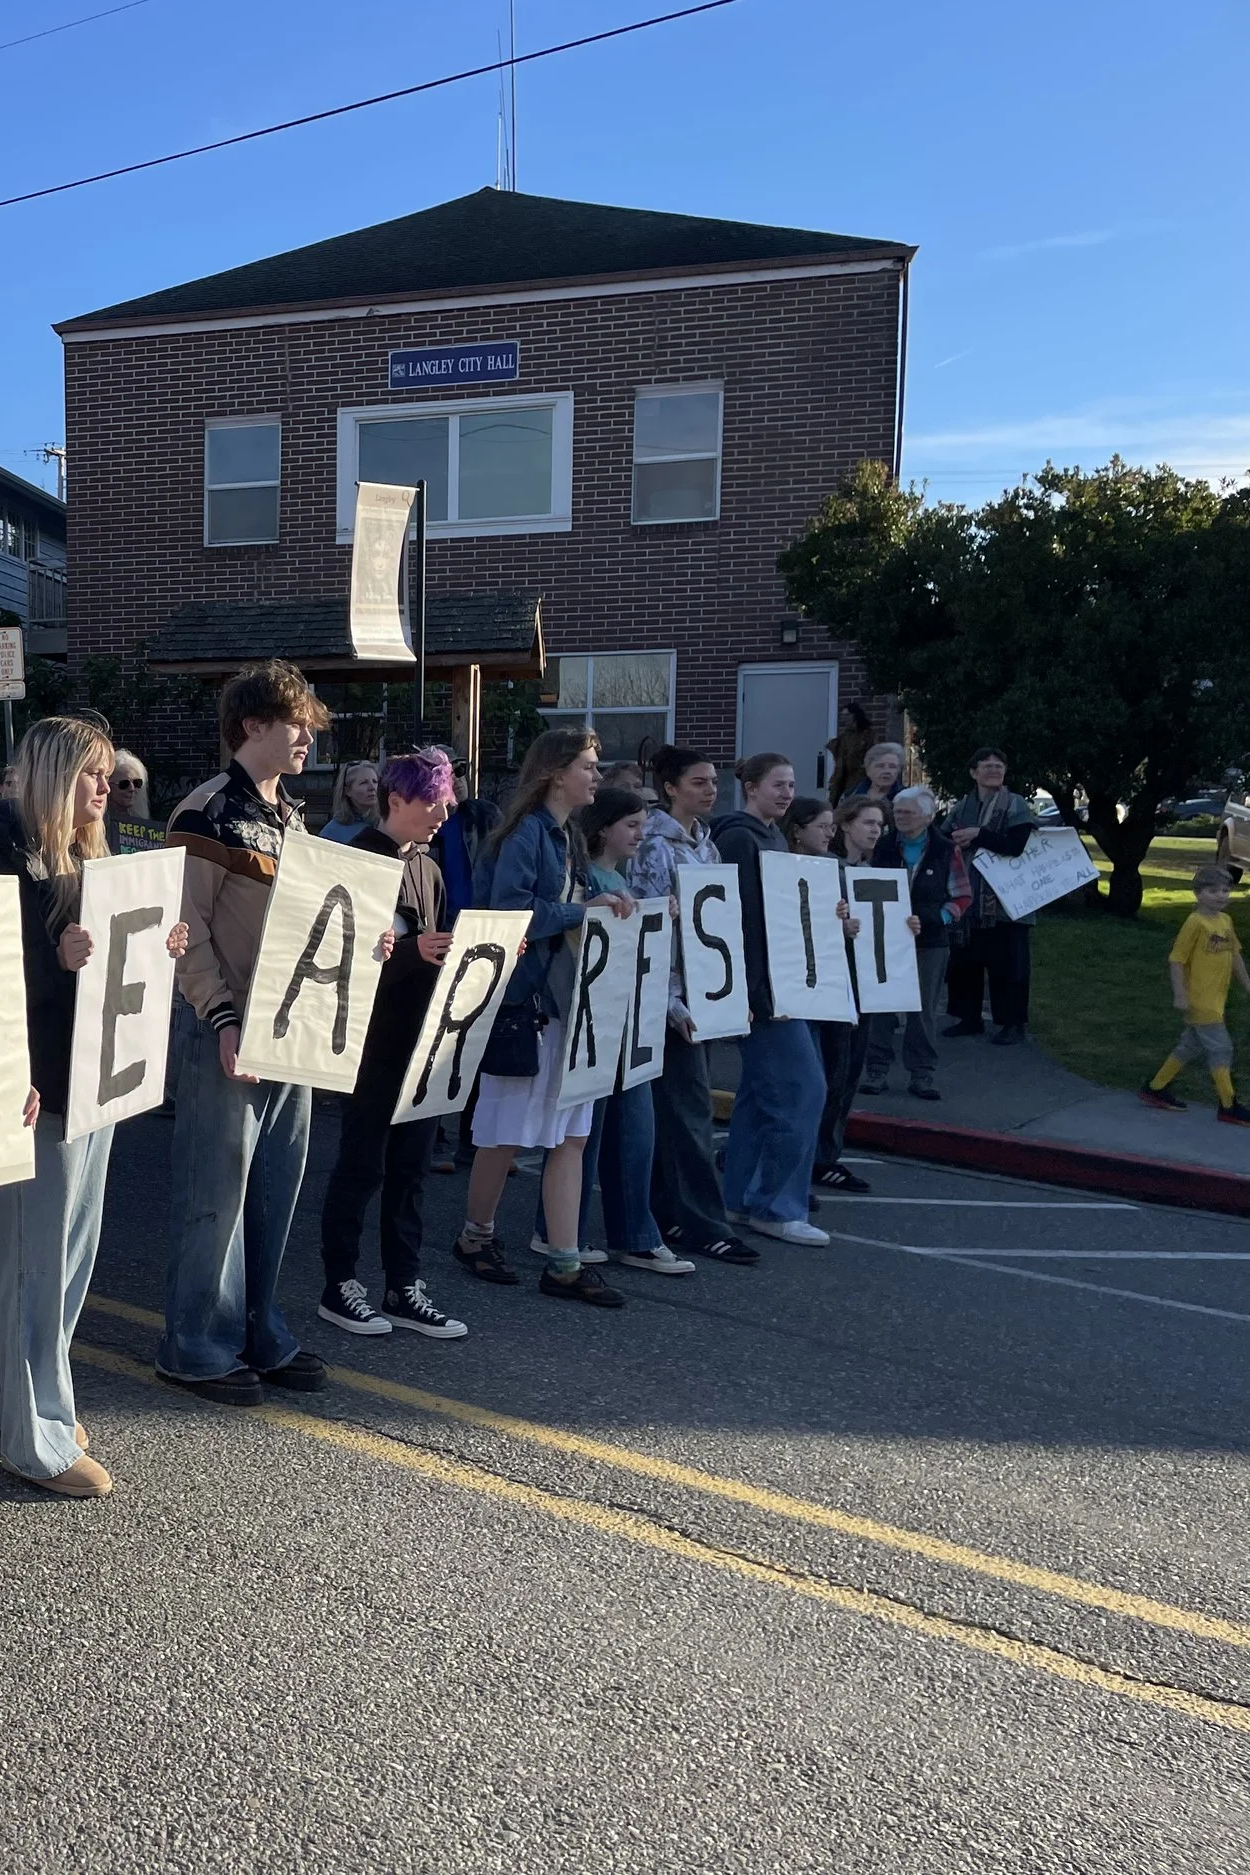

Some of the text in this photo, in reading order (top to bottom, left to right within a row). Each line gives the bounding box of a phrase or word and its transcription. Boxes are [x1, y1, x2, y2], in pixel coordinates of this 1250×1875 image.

[409, 354, 515, 376] LANGLEY CITY HALL
[0, 659, 14, 668] CARS
[1, 668, 14, 676] ONLY
[118, 821, 165, 842] KEEP THE
[1009, 838, 1054, 870] OTHER
[1031, 875, 1054, 891] ONE
[272, 884, 356, 1055] A
[693, 884, 733, 1001] S
[798, 877, 817, 989] I
[853, 878, 899, 984] T
[96, 906, 164, 1106] E
[412, 942, 506, 1107] R
[568, 917, 610, 1072] R
[629, 912, 664, 1070] E
